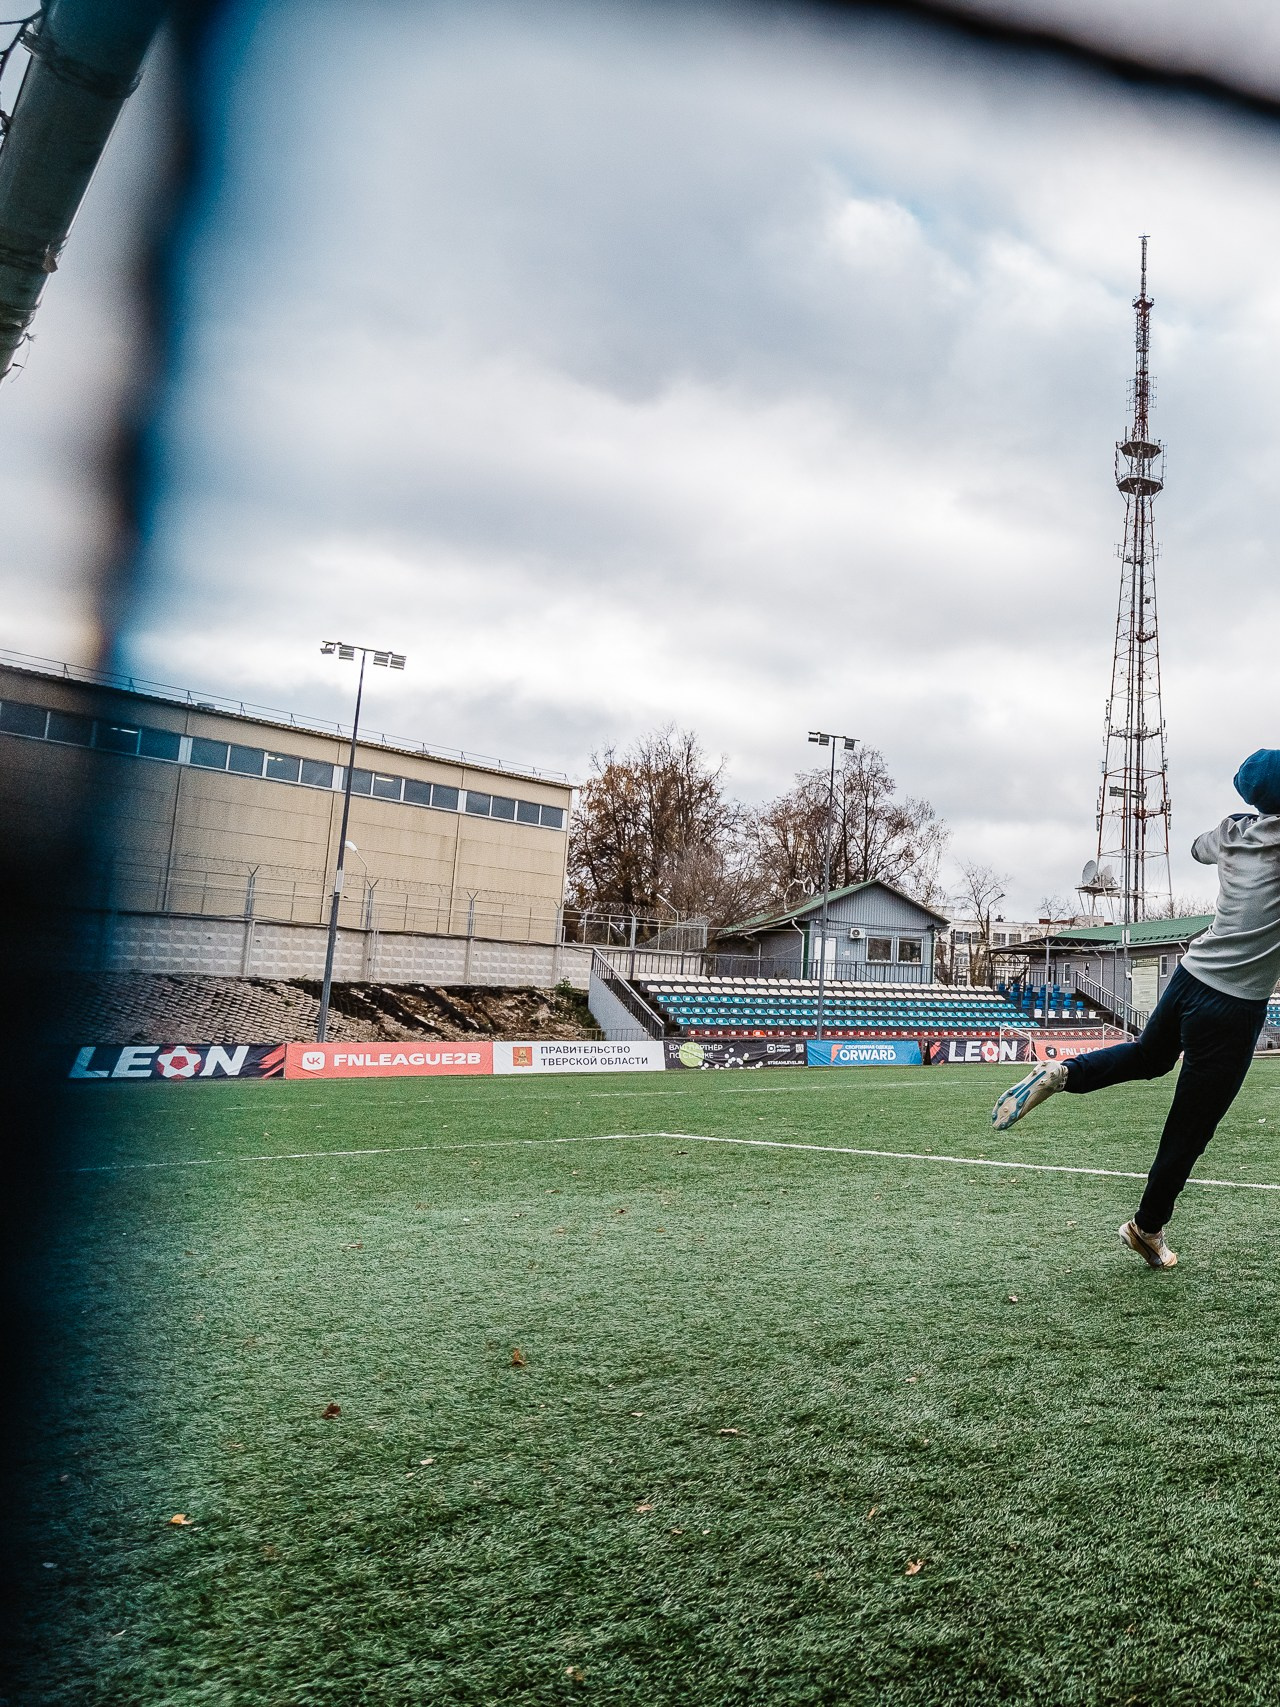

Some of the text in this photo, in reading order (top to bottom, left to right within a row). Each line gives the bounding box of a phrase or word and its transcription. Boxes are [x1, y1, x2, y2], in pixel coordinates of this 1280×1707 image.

[540, 1045, 631, 1055] ПРАВИТЕЛЬСТВО
[948, 1041, 1018, 1063] LEON
[68, 1045, 250, 1079] LEON
[334, 1052, 482, 1067] FNLEAGUE2B
[540, 1056, 649, 1066] ТВЕРСКОЙ ОБЛАСТИ
